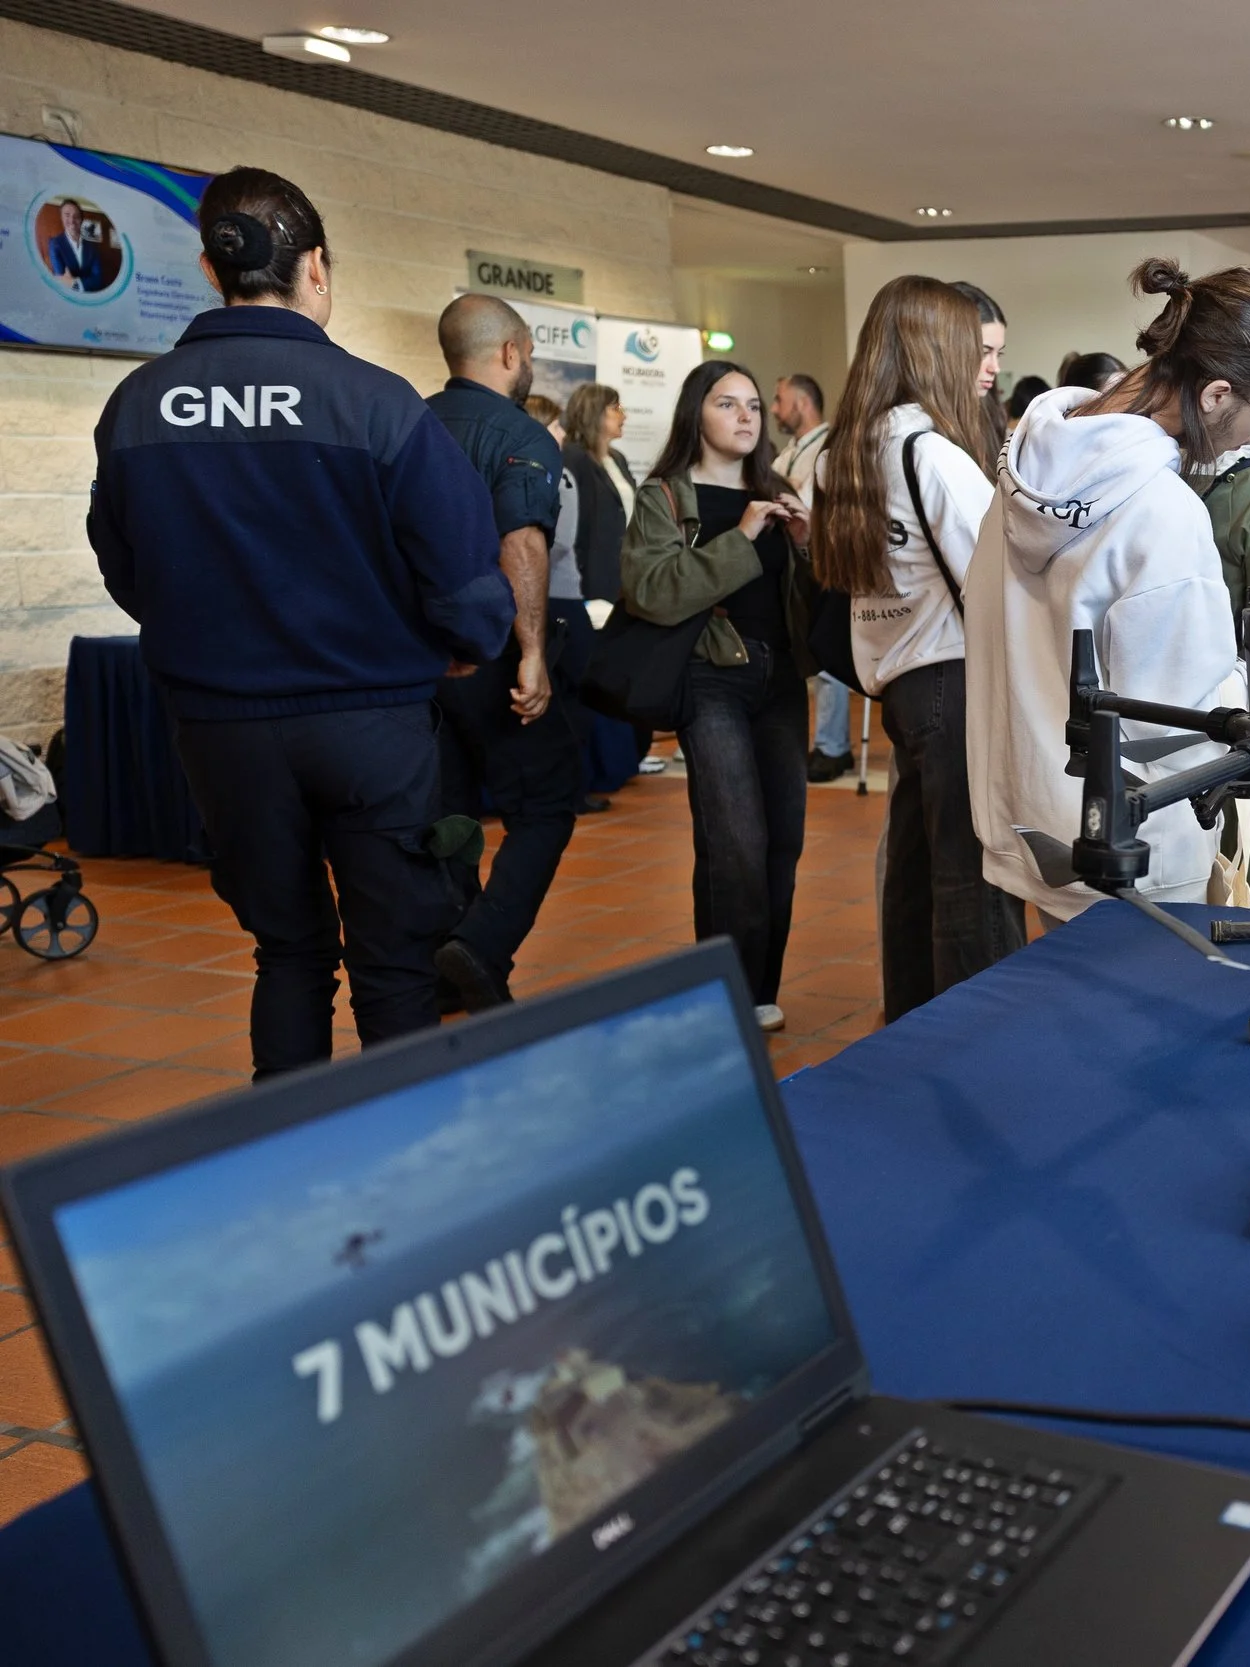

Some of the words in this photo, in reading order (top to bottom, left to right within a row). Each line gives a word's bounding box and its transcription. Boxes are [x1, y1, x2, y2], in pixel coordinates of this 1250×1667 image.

[477, 262, 555, 295] GRANDE
[160, 385, 303, 428] GNR
[292, 1338, 342, 1424] 7
[354, 1166, 711, 1395] MUNICÍPIOS
